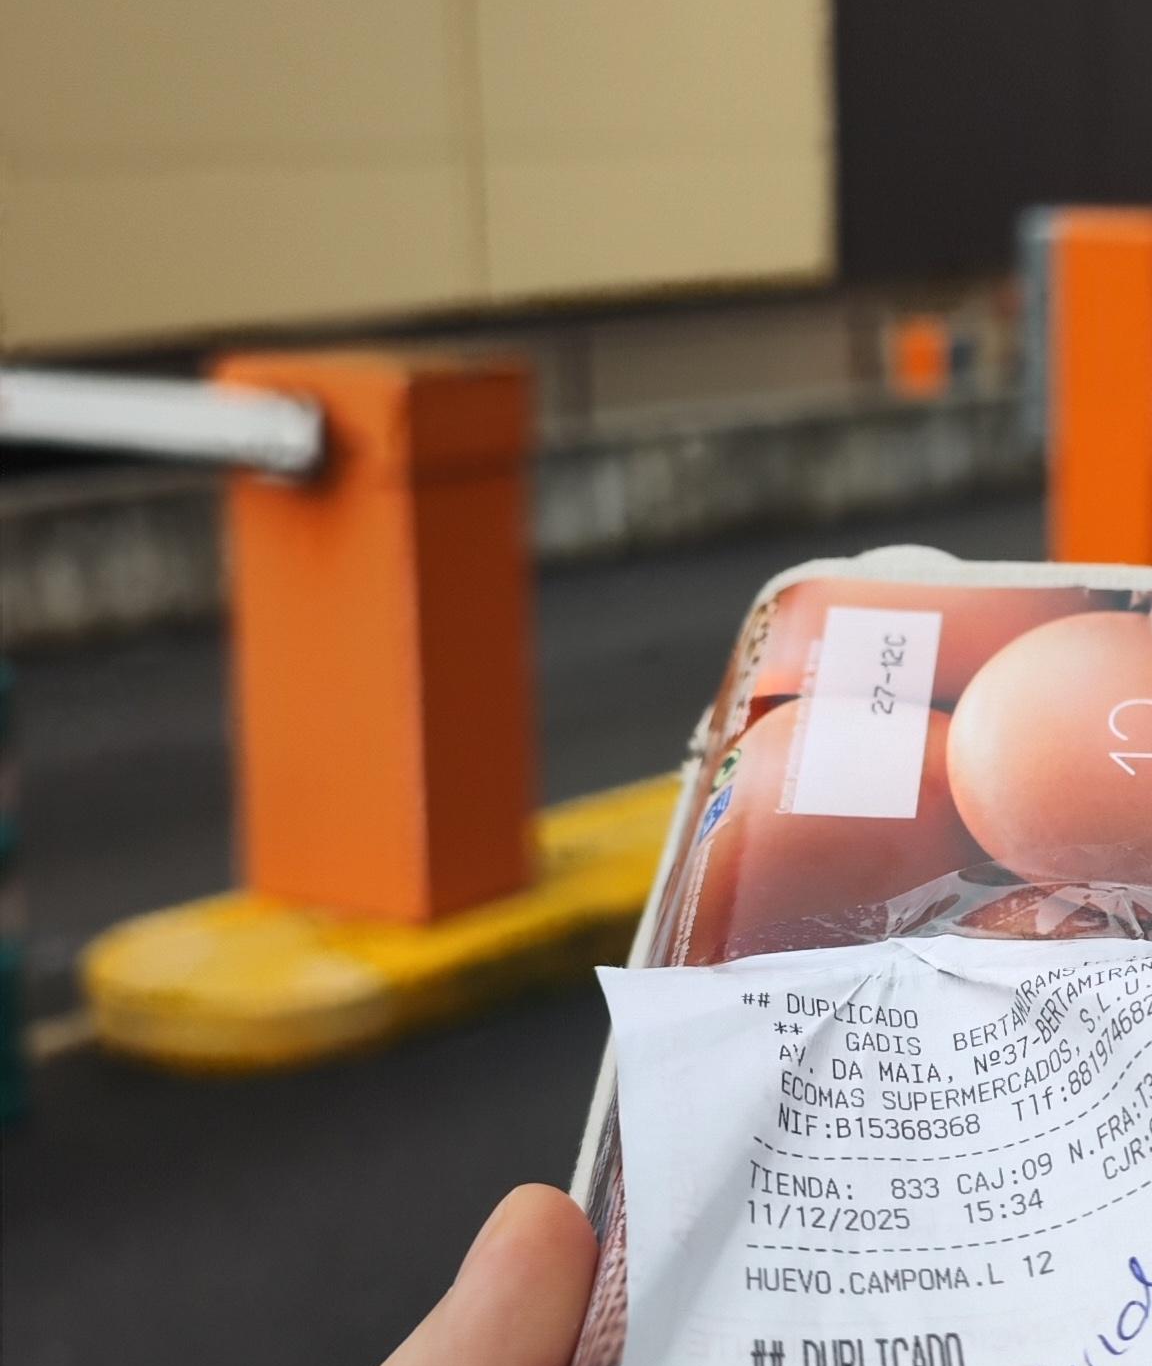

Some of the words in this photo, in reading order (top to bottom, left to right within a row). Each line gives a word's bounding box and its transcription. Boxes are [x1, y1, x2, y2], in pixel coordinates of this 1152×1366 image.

[786, 993, 918, 1029] DUPLICADO
[845, 1031, 921, 1056] GADIS
[952, 966, 1076, 1052] BERTAMIRANS
[781, 1070, 866, 1109] ECOMAS
[881, 1038, 1082, 1112] SUPERMERCADOS,
[1079, 978, 1152, 1034] S.L.U.
[832, 1058, 863, 1081] DA
[878, 1061, 955, 1085] MAIA,
[778, 1102, 982, 1141] NIF:B15368368
[749, 1159, 855, 1201] TIENDA:
[889, 1177, 941, 1200] 833
[956, 1152, 1053, 1196] CAJ:09
[746, 1199, 911, 1233] 11/12/2025
[962, 1188, 1044, 1225] 15:34
[746, 1262, 1005, 1296] HUEVO.CAMPOMA.L
[1022, 1251, 1055, 1277] 12
